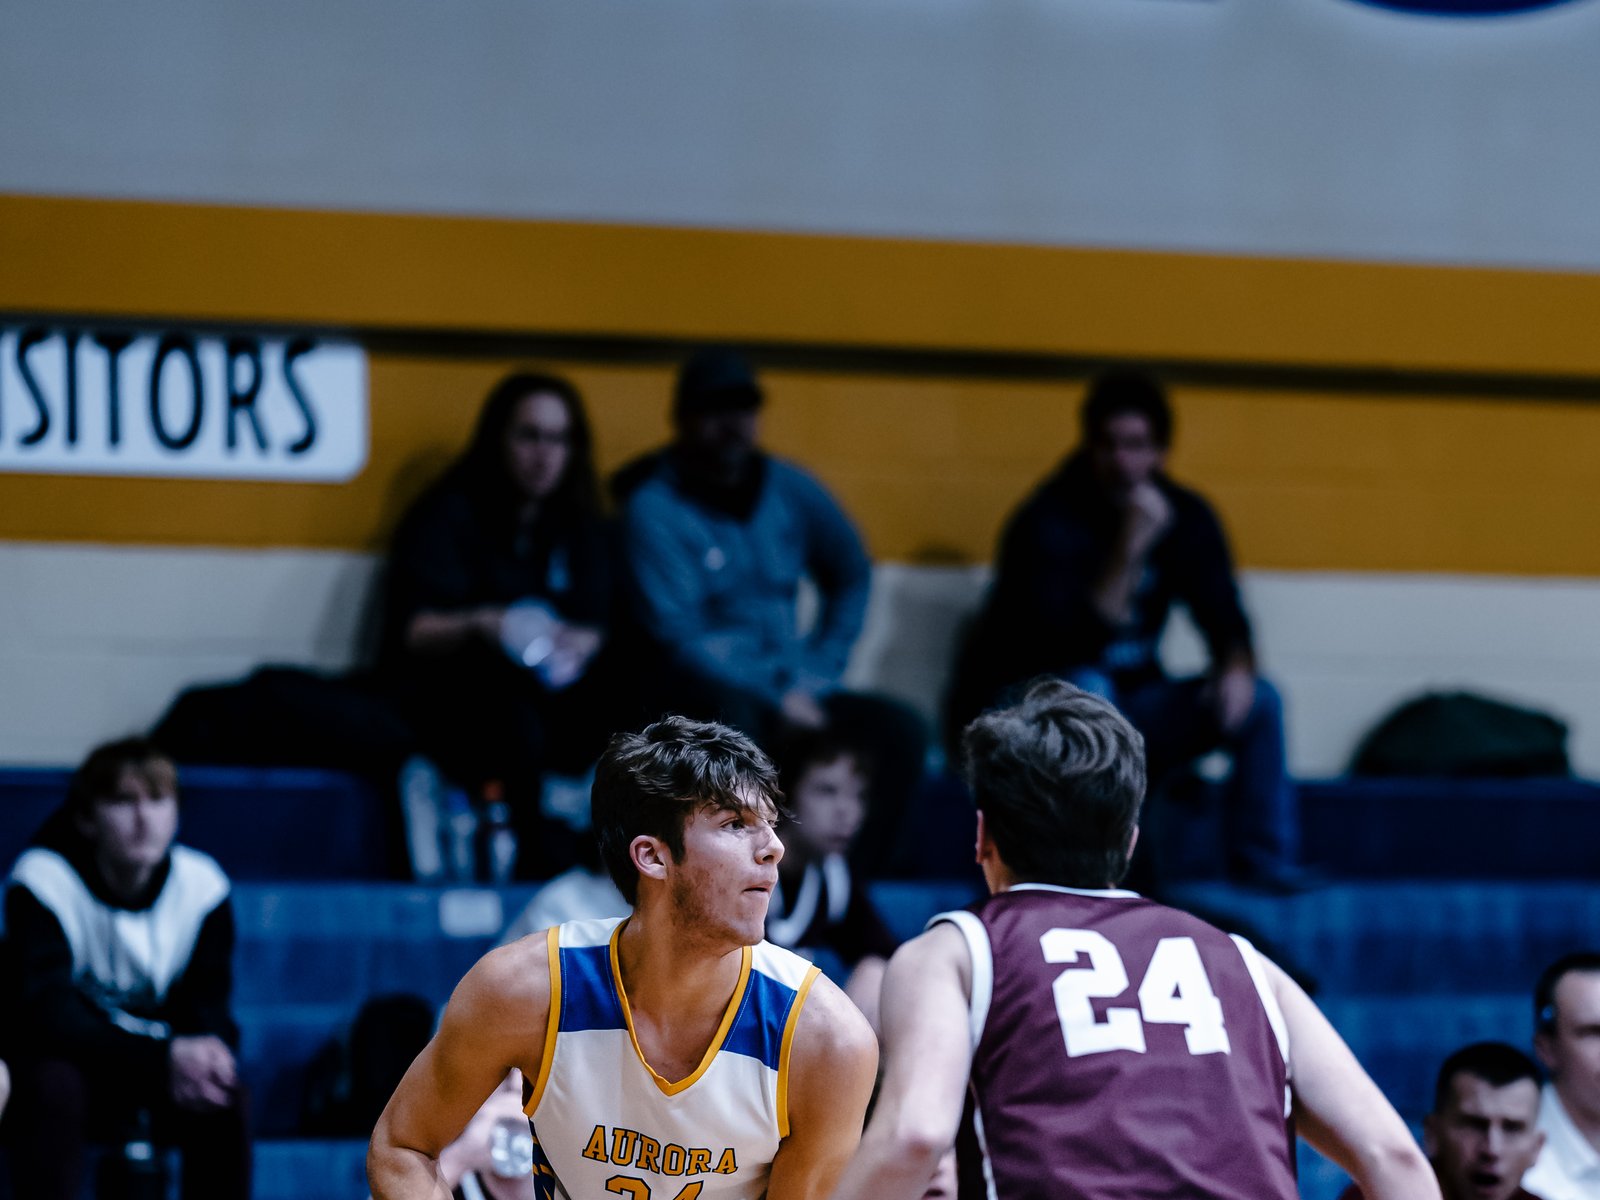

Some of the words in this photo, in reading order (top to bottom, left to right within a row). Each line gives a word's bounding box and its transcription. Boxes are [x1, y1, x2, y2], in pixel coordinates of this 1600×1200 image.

[0, 330, 318, 454] SITORS
[1040, 928, 1231, 1057] 24
[582, 1125, 738, 1176] AURORA
